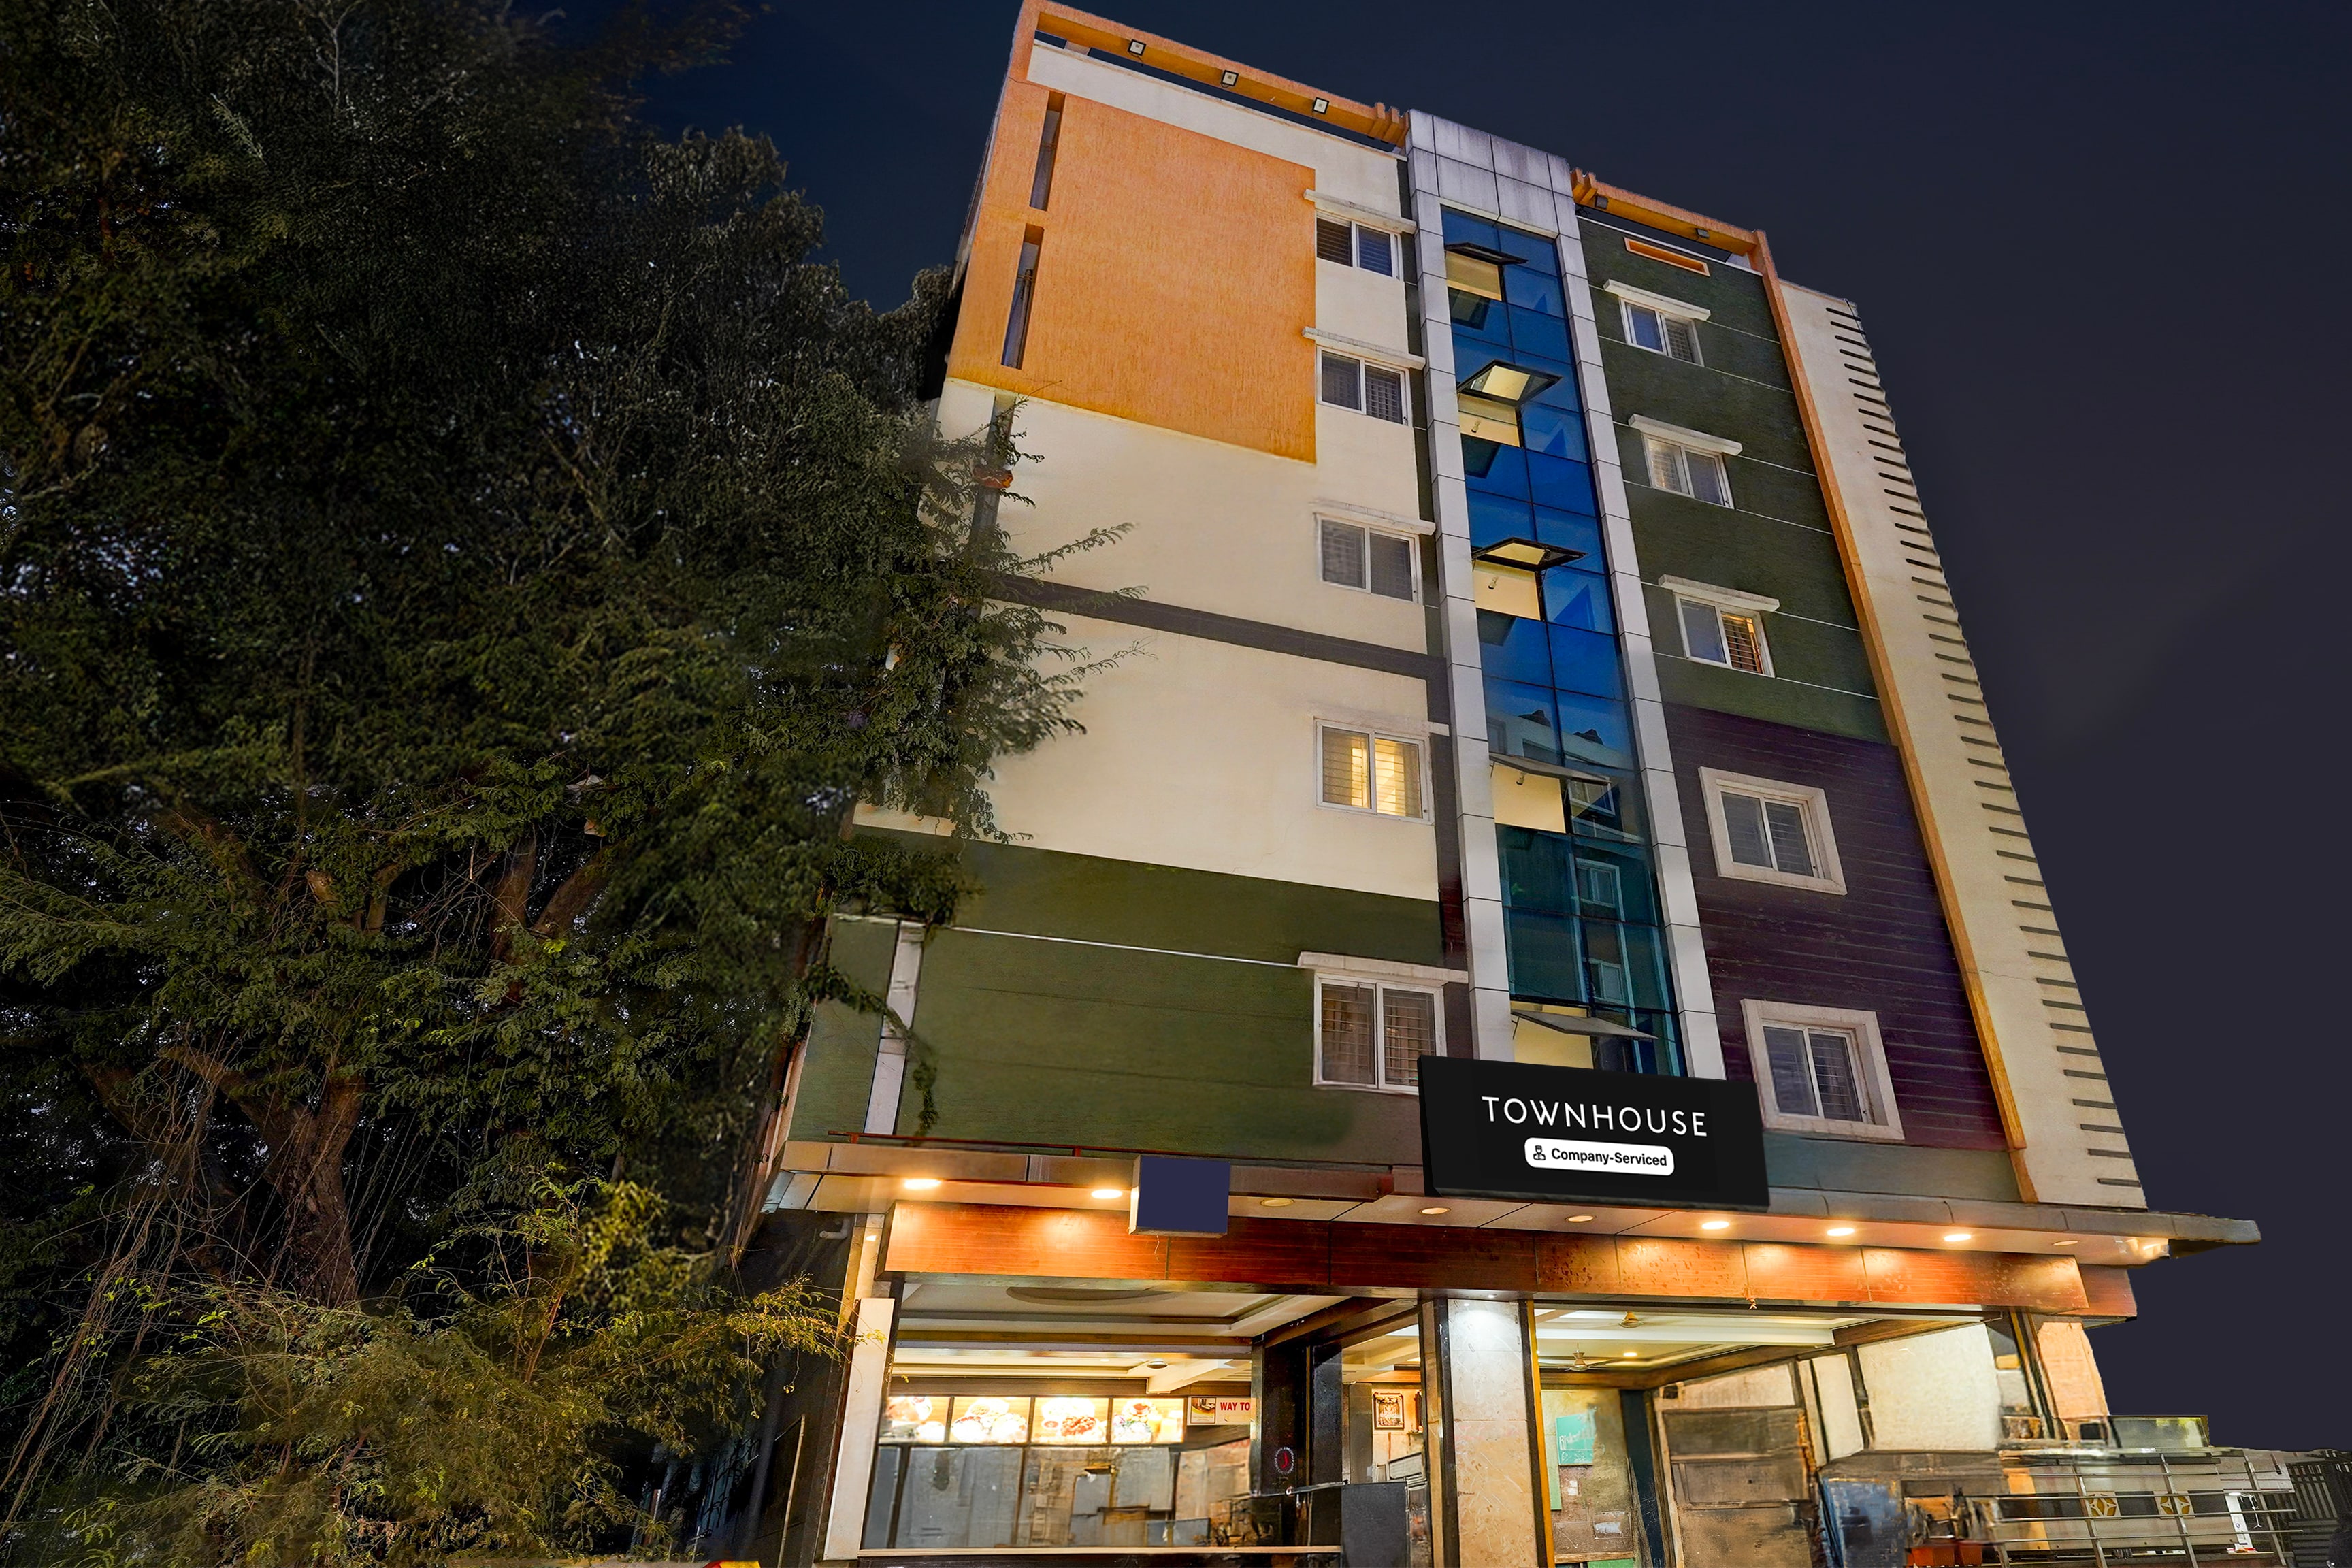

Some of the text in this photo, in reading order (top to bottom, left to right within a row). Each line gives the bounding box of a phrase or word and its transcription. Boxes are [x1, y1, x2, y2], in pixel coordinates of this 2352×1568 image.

[1482, 1096, 1707, 1137] TOWNHOUSE
[1551, 1148, 1667, 1166] Company-Serviced
[1220, 1402, 1251, 1411] WAY TO
